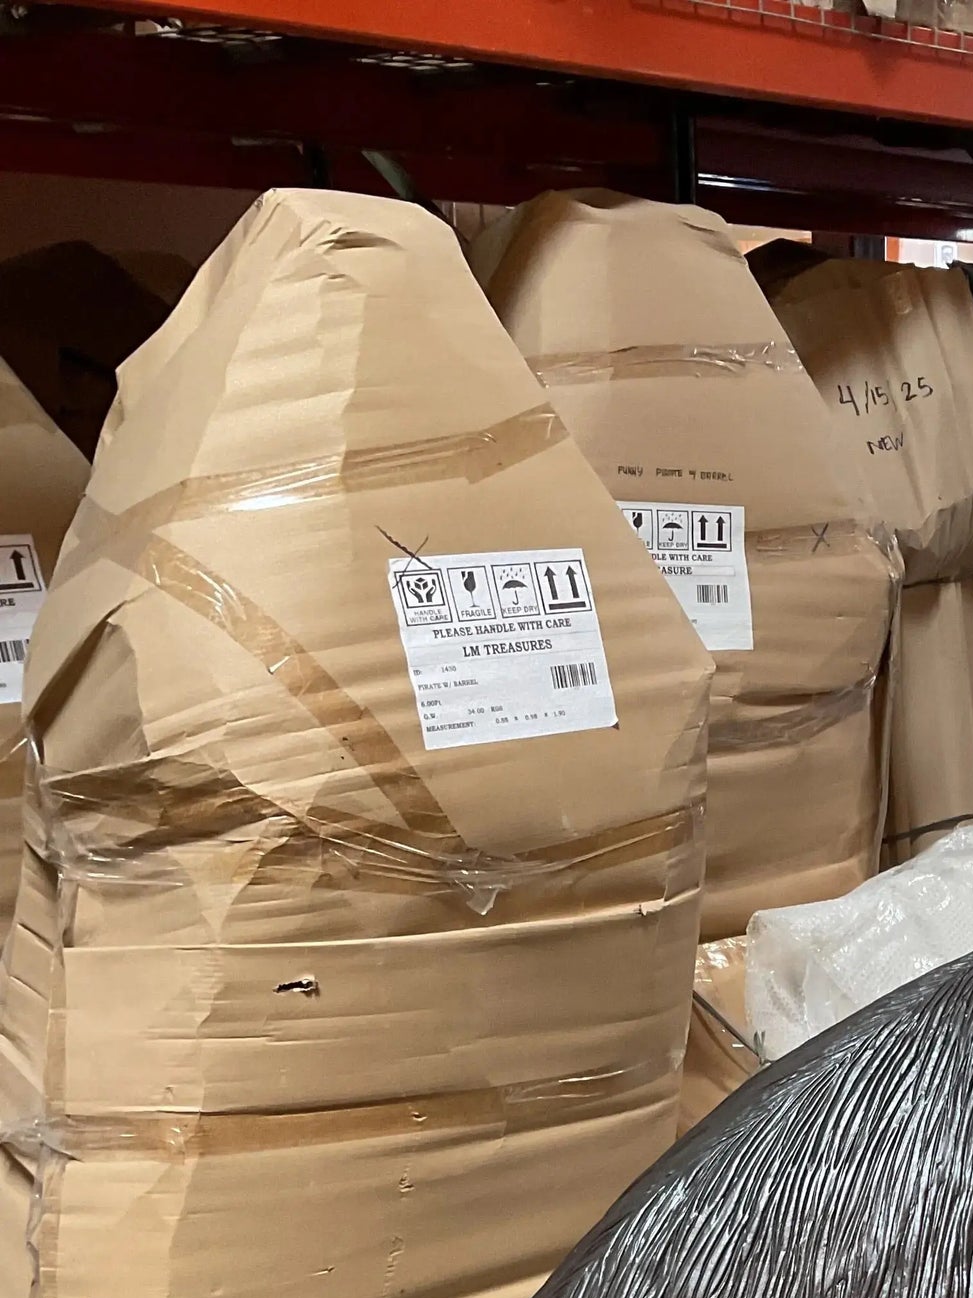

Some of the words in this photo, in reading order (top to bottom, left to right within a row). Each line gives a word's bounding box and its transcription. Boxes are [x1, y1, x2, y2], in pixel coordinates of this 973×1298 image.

[866, 432, 904, 455] NEW
[669, 553, 690, 561] WITH
[691, 554, 713, 562] CARE
[658, 566, 693, 575] ASURE
[413, 609, 442, 617] HANDLE
[461, 607, 493, 618] FRAGILE
[502, 606, 523, 615] KEEP
[523, 605, 538, 614] DRY
[409, 615, 429, 623] WITH
[429, 613, 449, 622] CARE
[433, 626, 472, 639] PLEASE
[475, 622, 516, 635] HANDLE
[517, 620, 543, 632] WITH
[543, 618, 572, 629] CARE
[462, 645, 481, 658] LM
[483, 638, 553, 656] TREASURES
[418, 681, 442, 691] PIRATE
[453, 678, 479, 688] BARREL
